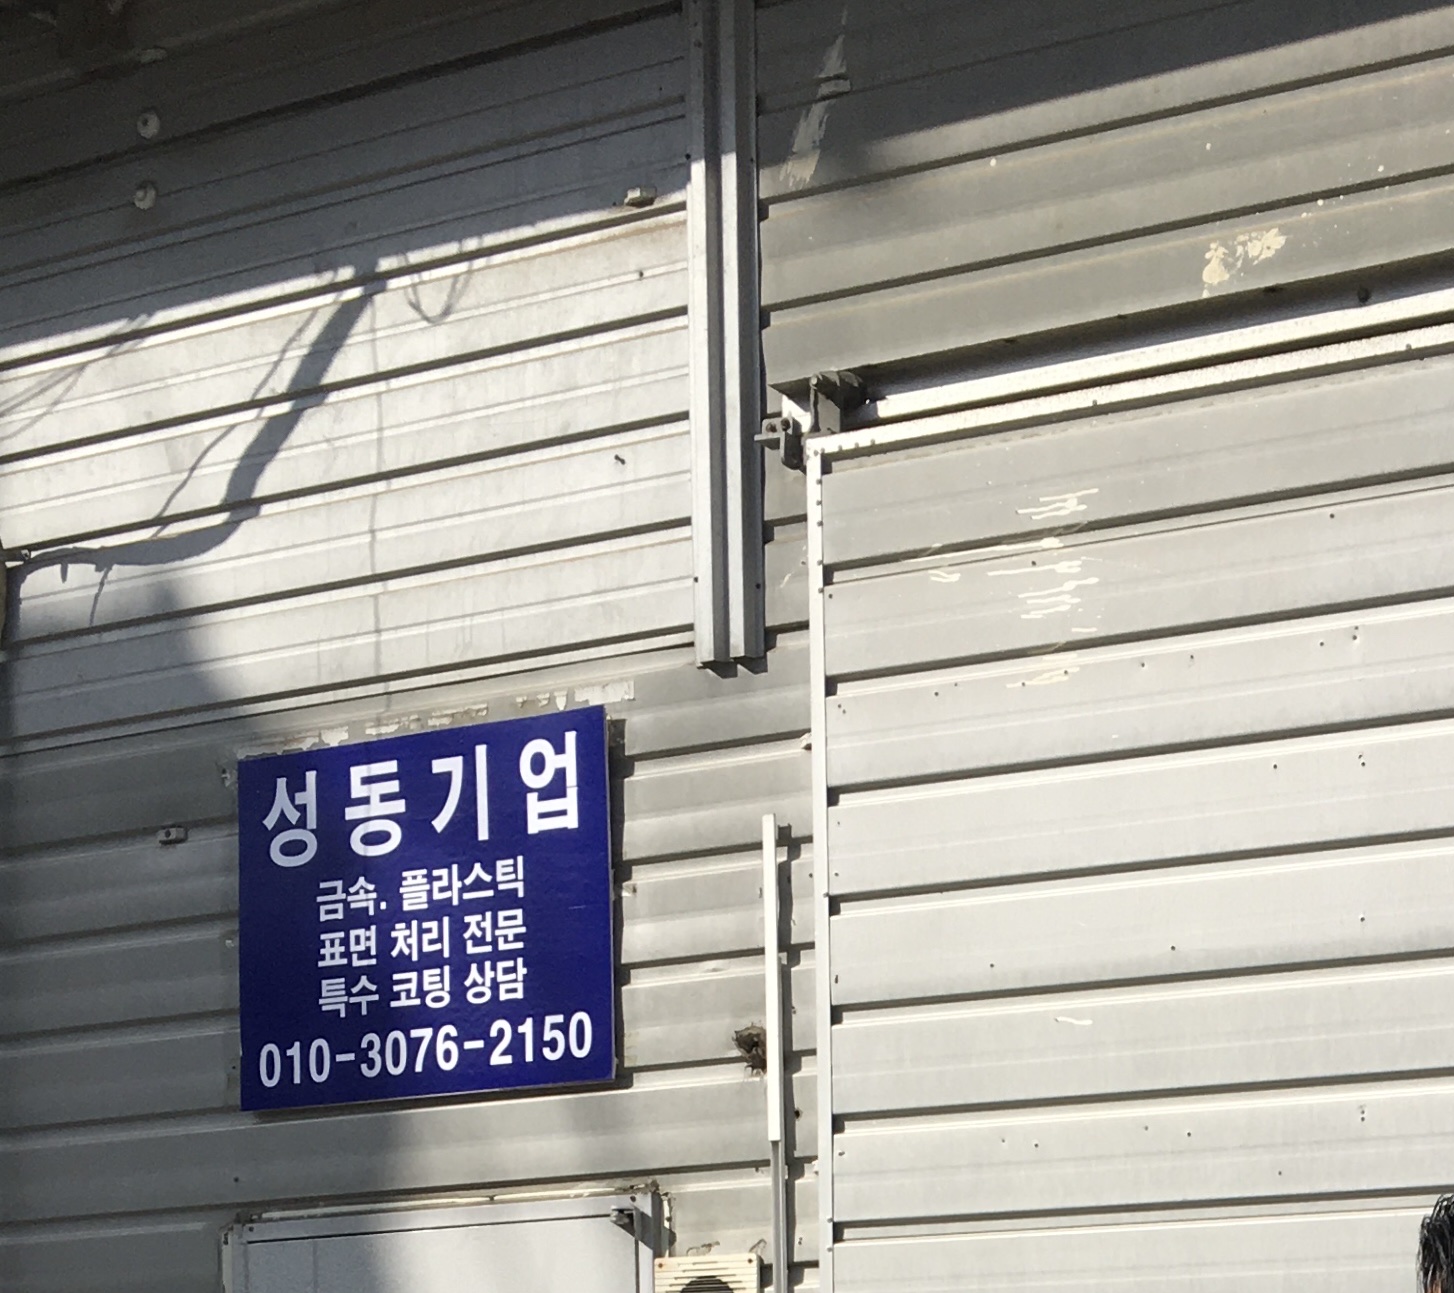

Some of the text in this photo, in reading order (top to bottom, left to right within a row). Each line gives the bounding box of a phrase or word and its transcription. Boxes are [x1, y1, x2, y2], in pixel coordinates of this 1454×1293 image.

[261, 730, 580, 868] 성동기업
[399, 855, 525, 911] 플라스틱
[317, 909, 527, 968] 표면 처리 전문
[318, 957, 527, 1018] 특수 코팅 상담
[259, 1011, 593, 1088] 010-3076-2150
